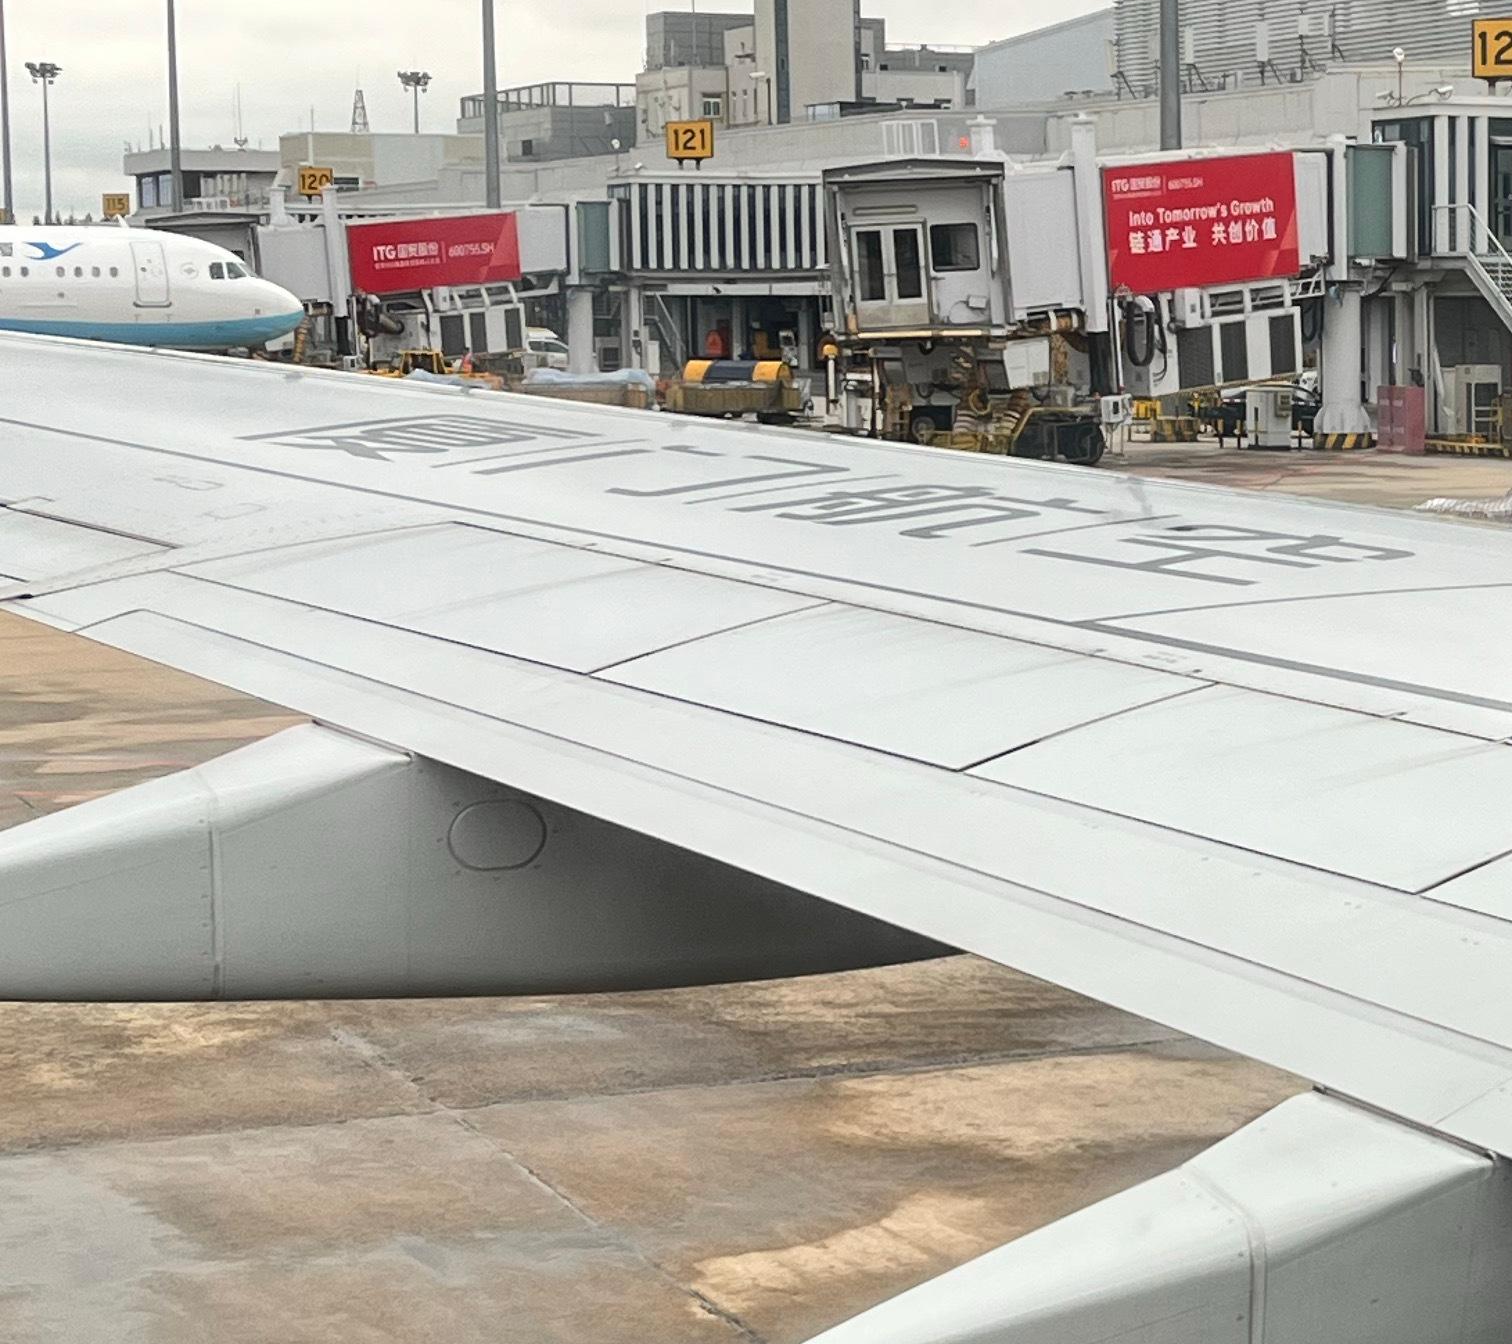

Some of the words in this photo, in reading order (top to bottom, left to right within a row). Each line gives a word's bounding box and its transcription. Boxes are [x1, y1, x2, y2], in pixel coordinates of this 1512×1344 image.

[673, 128, 706, 151] 121
[301, 174, 330, 190] 120
[1129, 210, 1154, 227] Into
[1156, 203, 1228, 224] Tomorrow's
[1230, 197, 1274, 215] Growth
[1211, 217, 1277, 246] 共创价值
[373, 245, 396, 261] ITG
